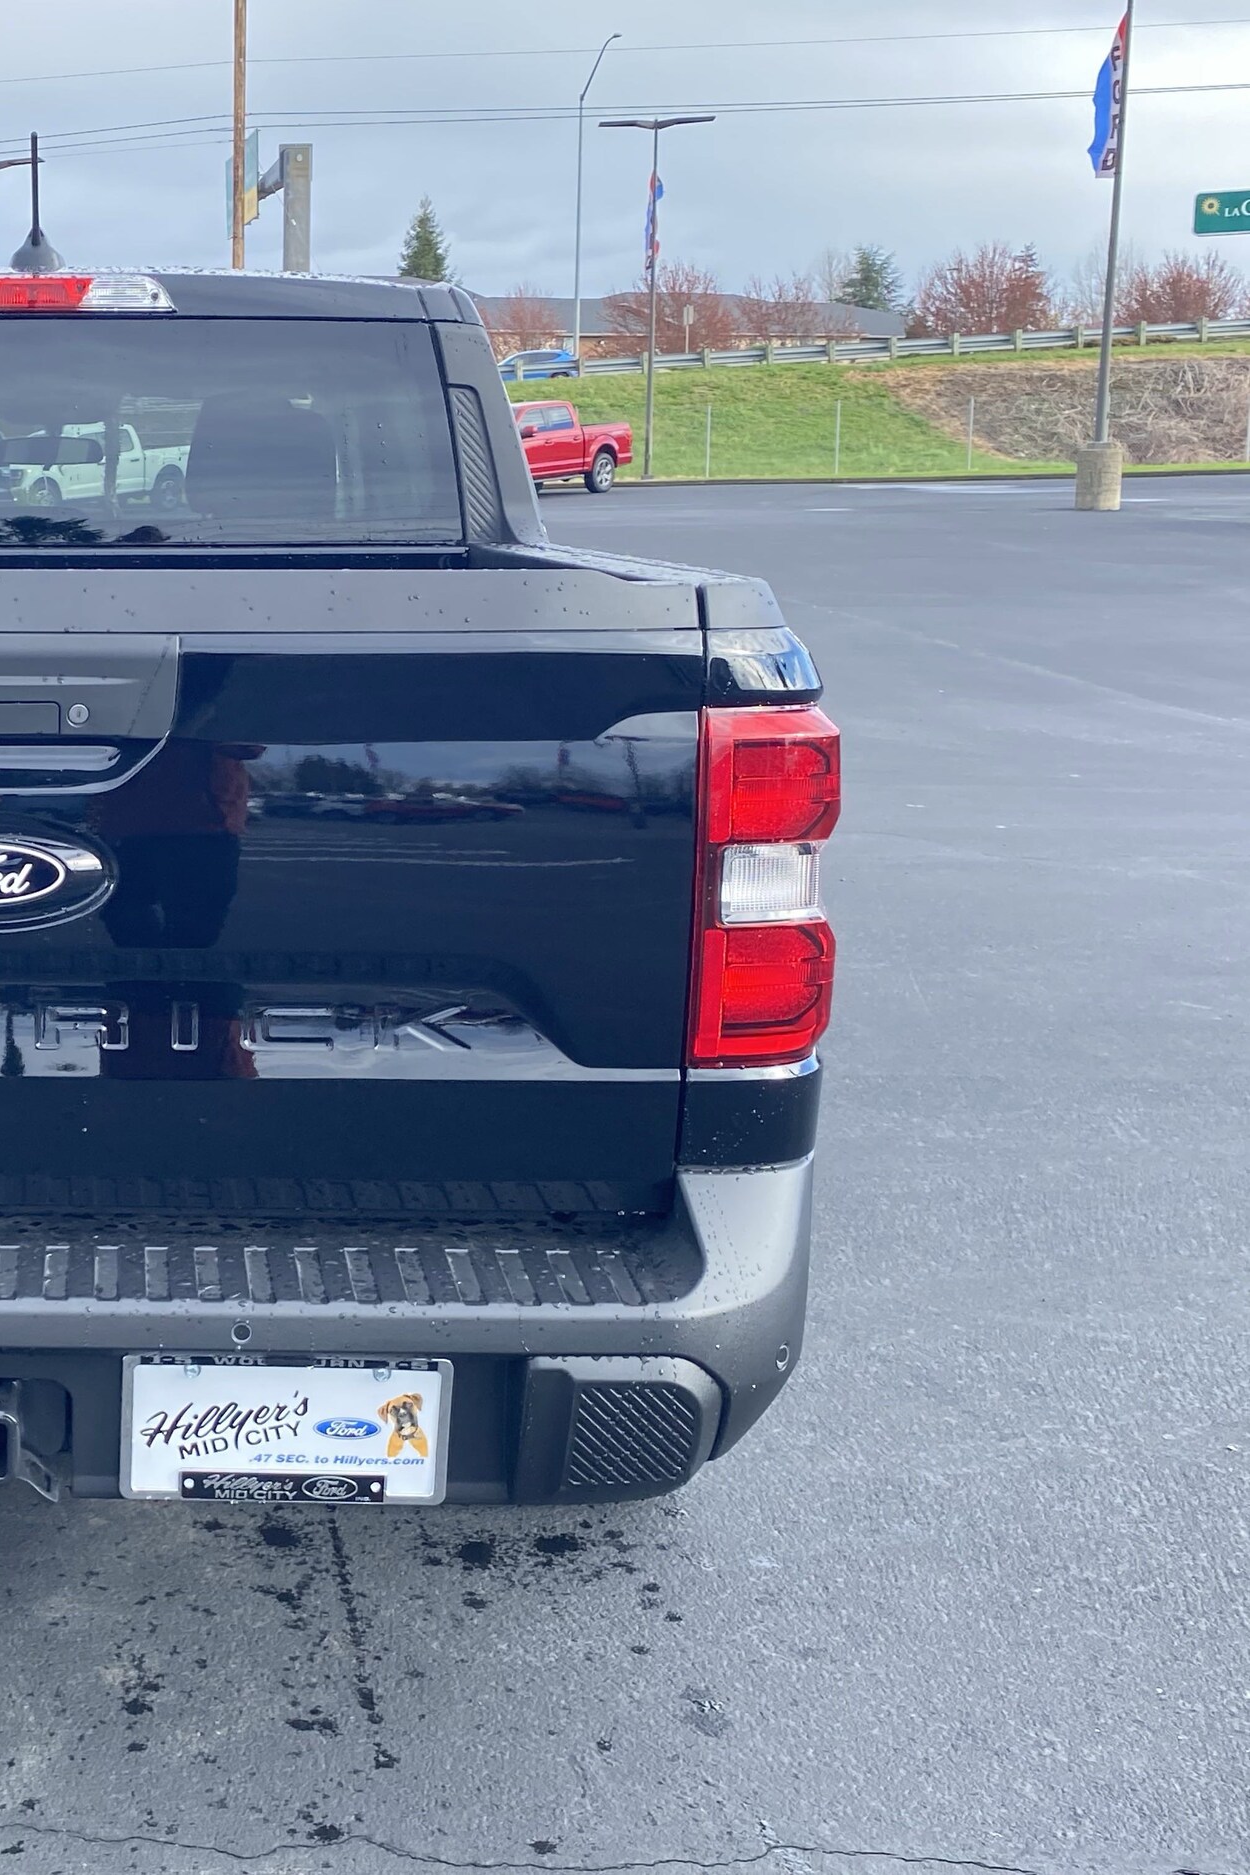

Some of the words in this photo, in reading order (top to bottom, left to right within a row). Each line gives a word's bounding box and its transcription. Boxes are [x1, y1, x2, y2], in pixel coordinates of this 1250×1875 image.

[140, 1390, 310, 1450] Hillyer's
[325, 1420, 369, 1437] Ford
[178, 1436, 229, 1460] MID
[245, 1421, 302, 1447] CITY
[275, 1454, 309, 1464] SEC.
[314, 1455, 329, 1464] to
[333, 1455, 425, 1467] Hillyers.com
[202, 1473, 295, 1494] Hillyer's
[312, 1478, 348, 1497] Ford
[214, 1489, 248, 1499] MID
[253, 1490, 298, 1500] CITY
